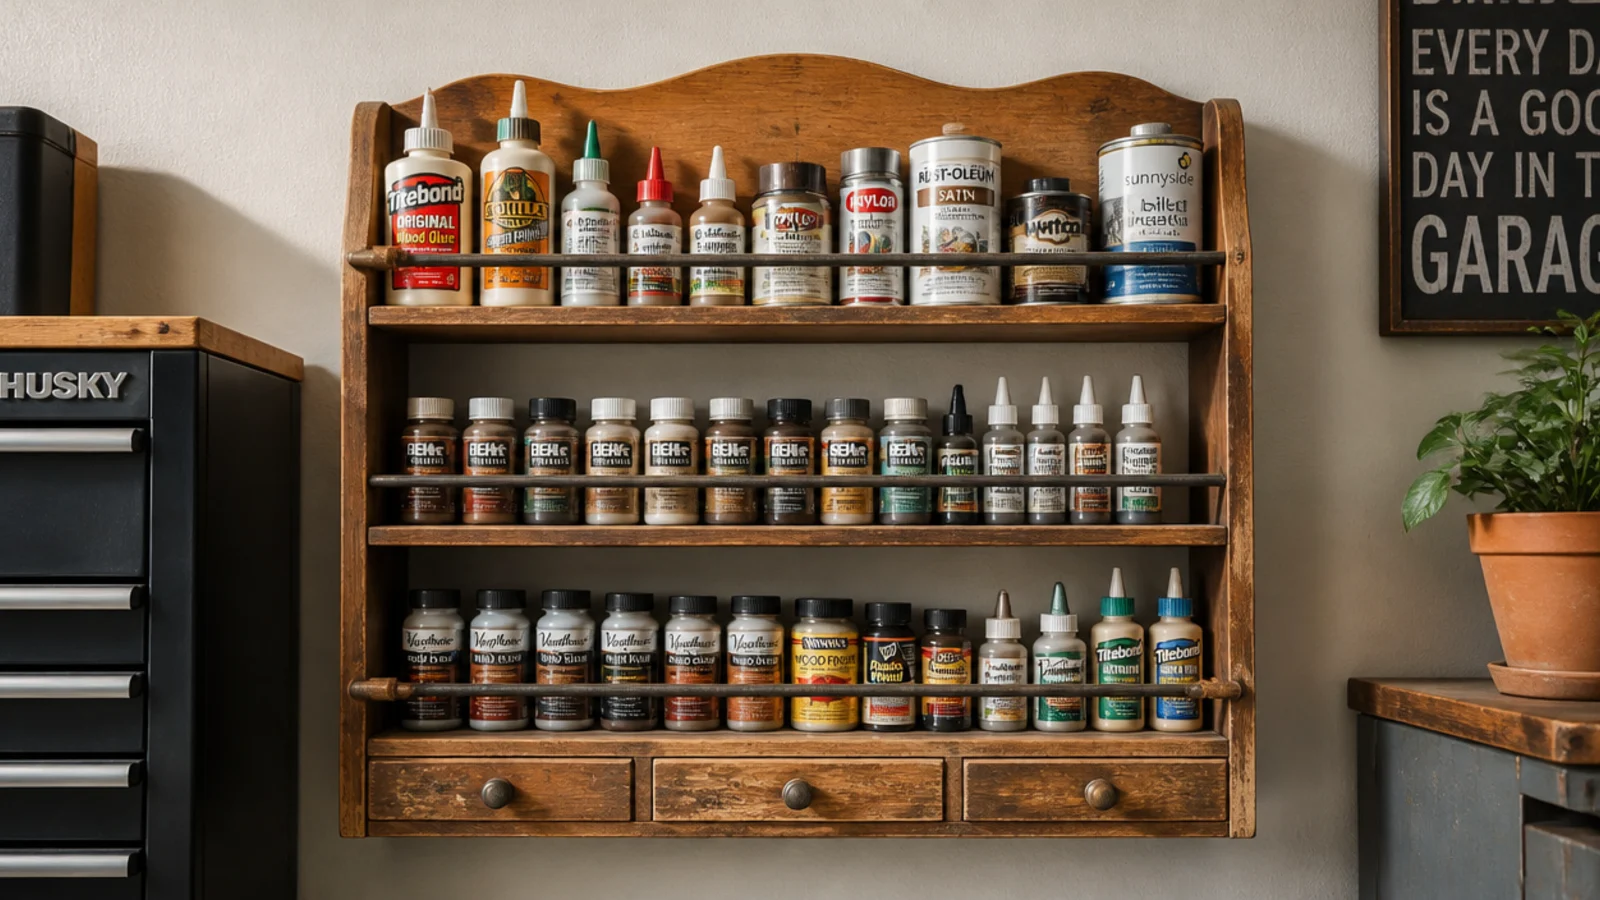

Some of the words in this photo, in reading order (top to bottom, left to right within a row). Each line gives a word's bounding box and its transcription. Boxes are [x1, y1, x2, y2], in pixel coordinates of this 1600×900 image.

[1412, 29, 1549, 75] EVERY
[1569, 29, 1600, 75] D
[1412, 89, 1450, 136] IS
[1470, 90, 1499, 136] A
[1125, 171, 1194, 188] sunnyside
[1412, 152, 1494, 198] DAY
[1515, 152, 1555, 198] IN
[397, 214, 455, 230] ORIGINAL
[0, 371, 128, 399] HUSKY
